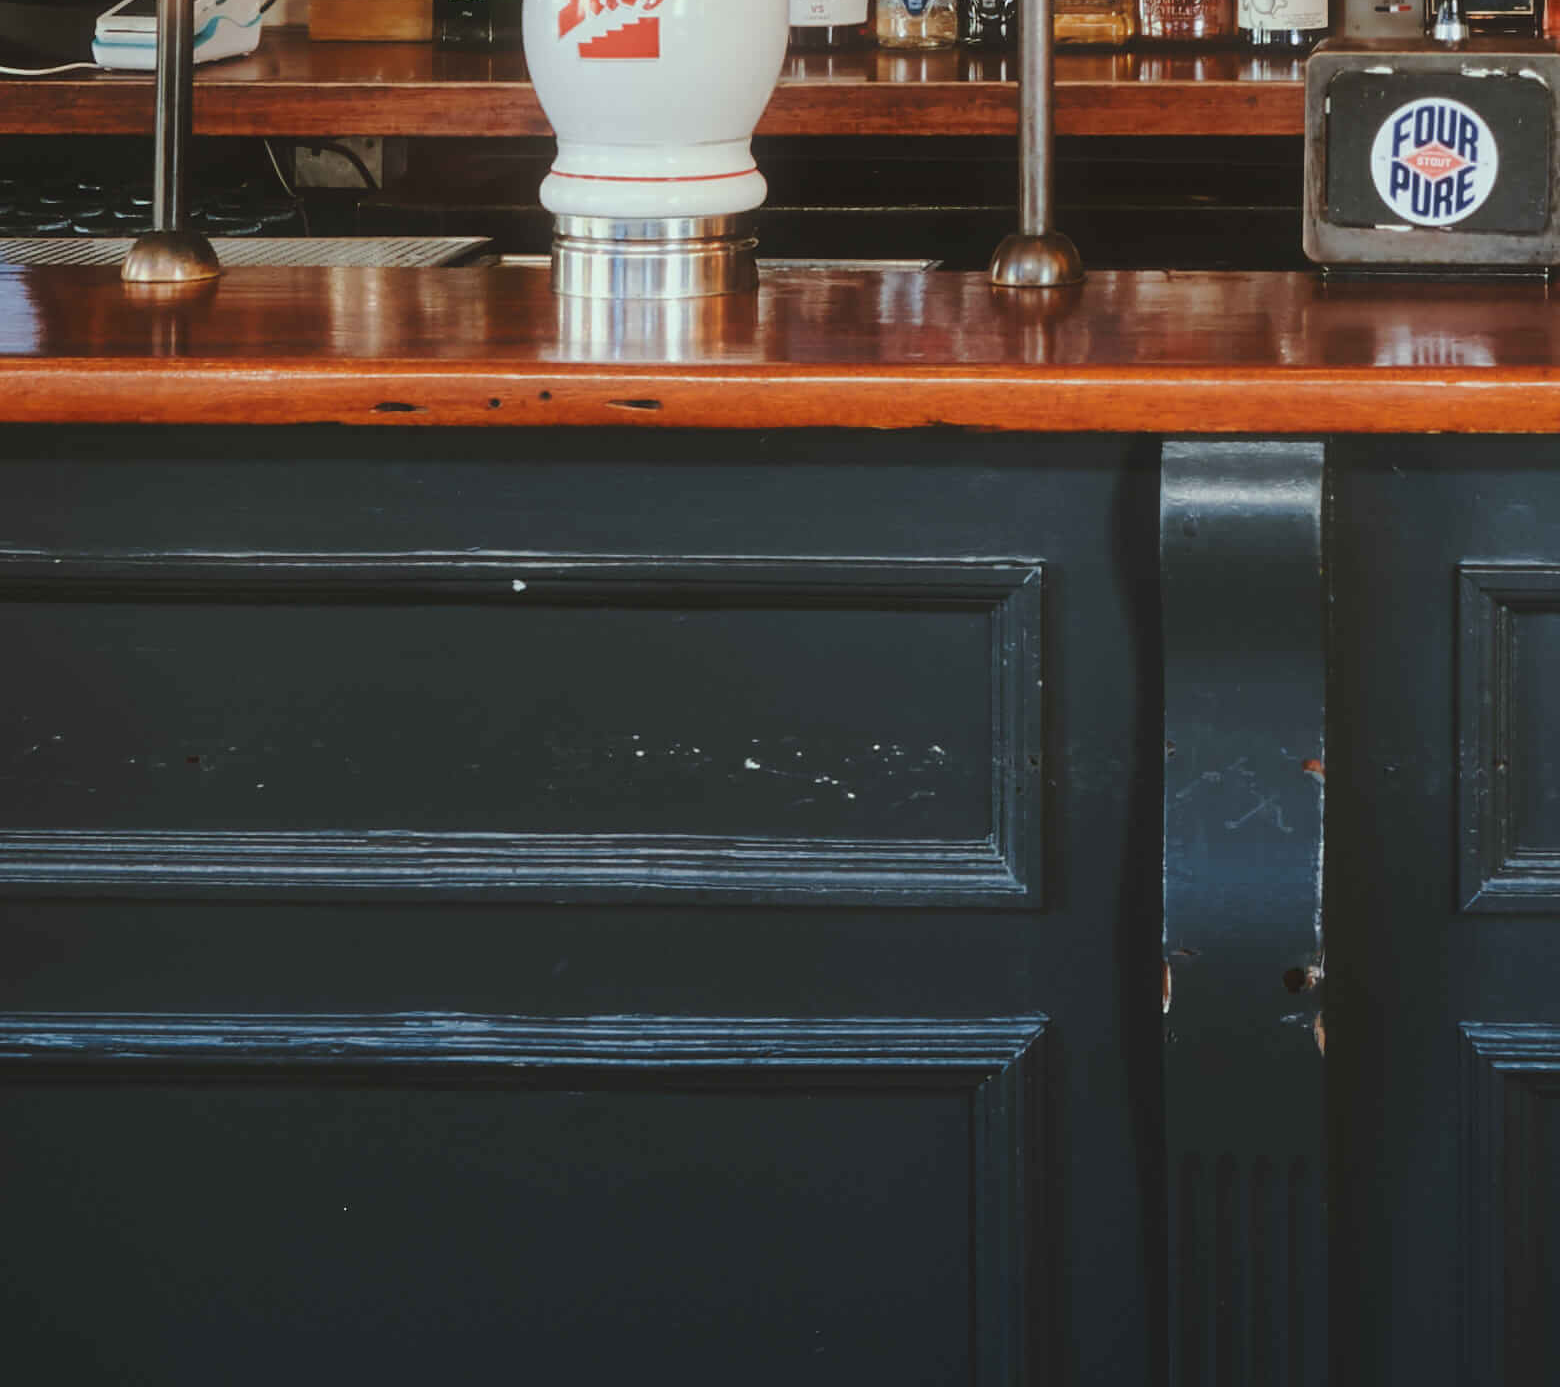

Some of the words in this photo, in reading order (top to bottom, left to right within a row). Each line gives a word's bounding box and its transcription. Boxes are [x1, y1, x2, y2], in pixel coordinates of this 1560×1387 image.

[1392, 104, 1479, 164] FOUR
[1415, 155, 1453, 169] STOUT
[1388, 164, 1478, 219] PURE
